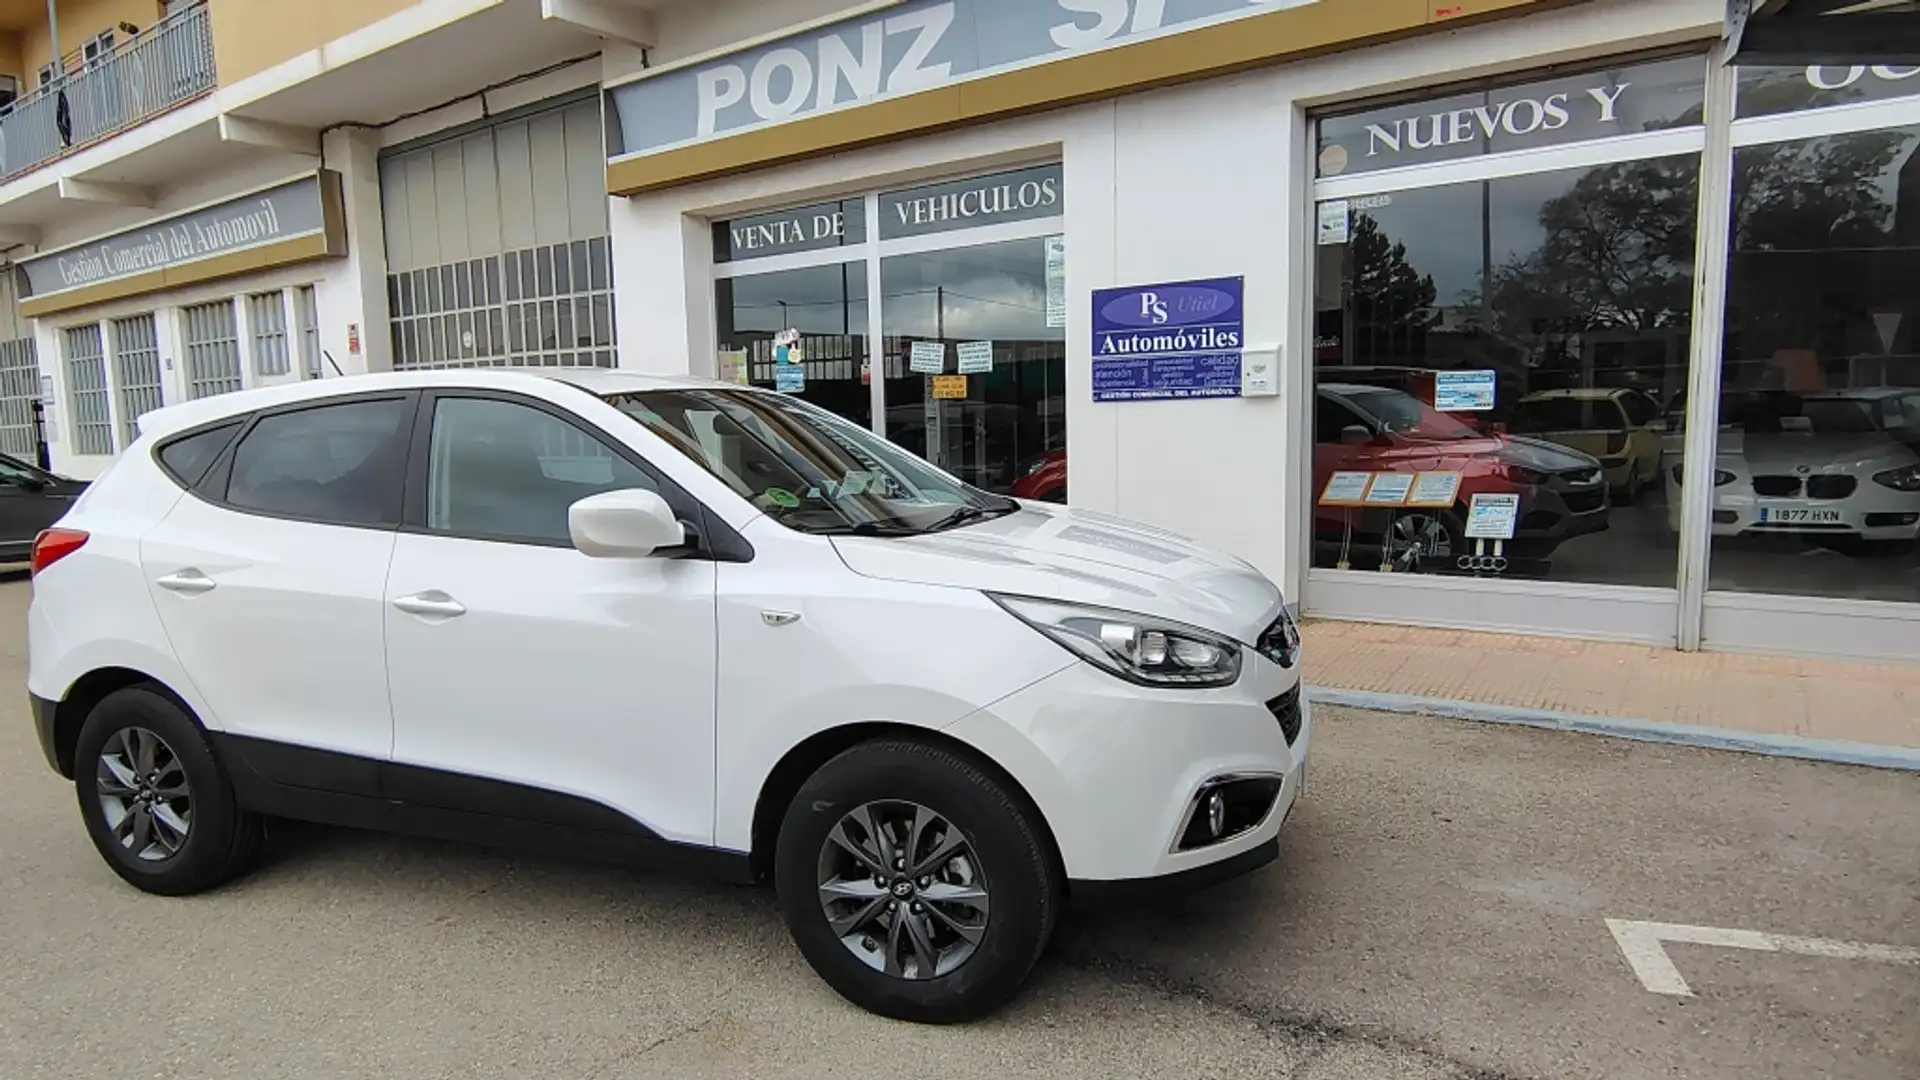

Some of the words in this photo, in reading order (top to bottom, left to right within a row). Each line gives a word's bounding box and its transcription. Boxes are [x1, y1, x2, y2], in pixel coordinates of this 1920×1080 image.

[697, 2, 955, 138] PONZ
[1365, 93, 1568, 155] NUEVOS
[1587, 82, 1630, 123] Y
[732, 221, 806, 249] VENTA
[814, 211, 845, 237] DE
[895, 178, 1057, 226] VEHICULOS
[101, 234, 170, 275] Comercial
[170, 222, 193, 258] del
[1100, 328, 1239, 354] Automóviles
[1775, 510, 1808, 520] 1877
[1812, 510, 1839, 520] HXN
